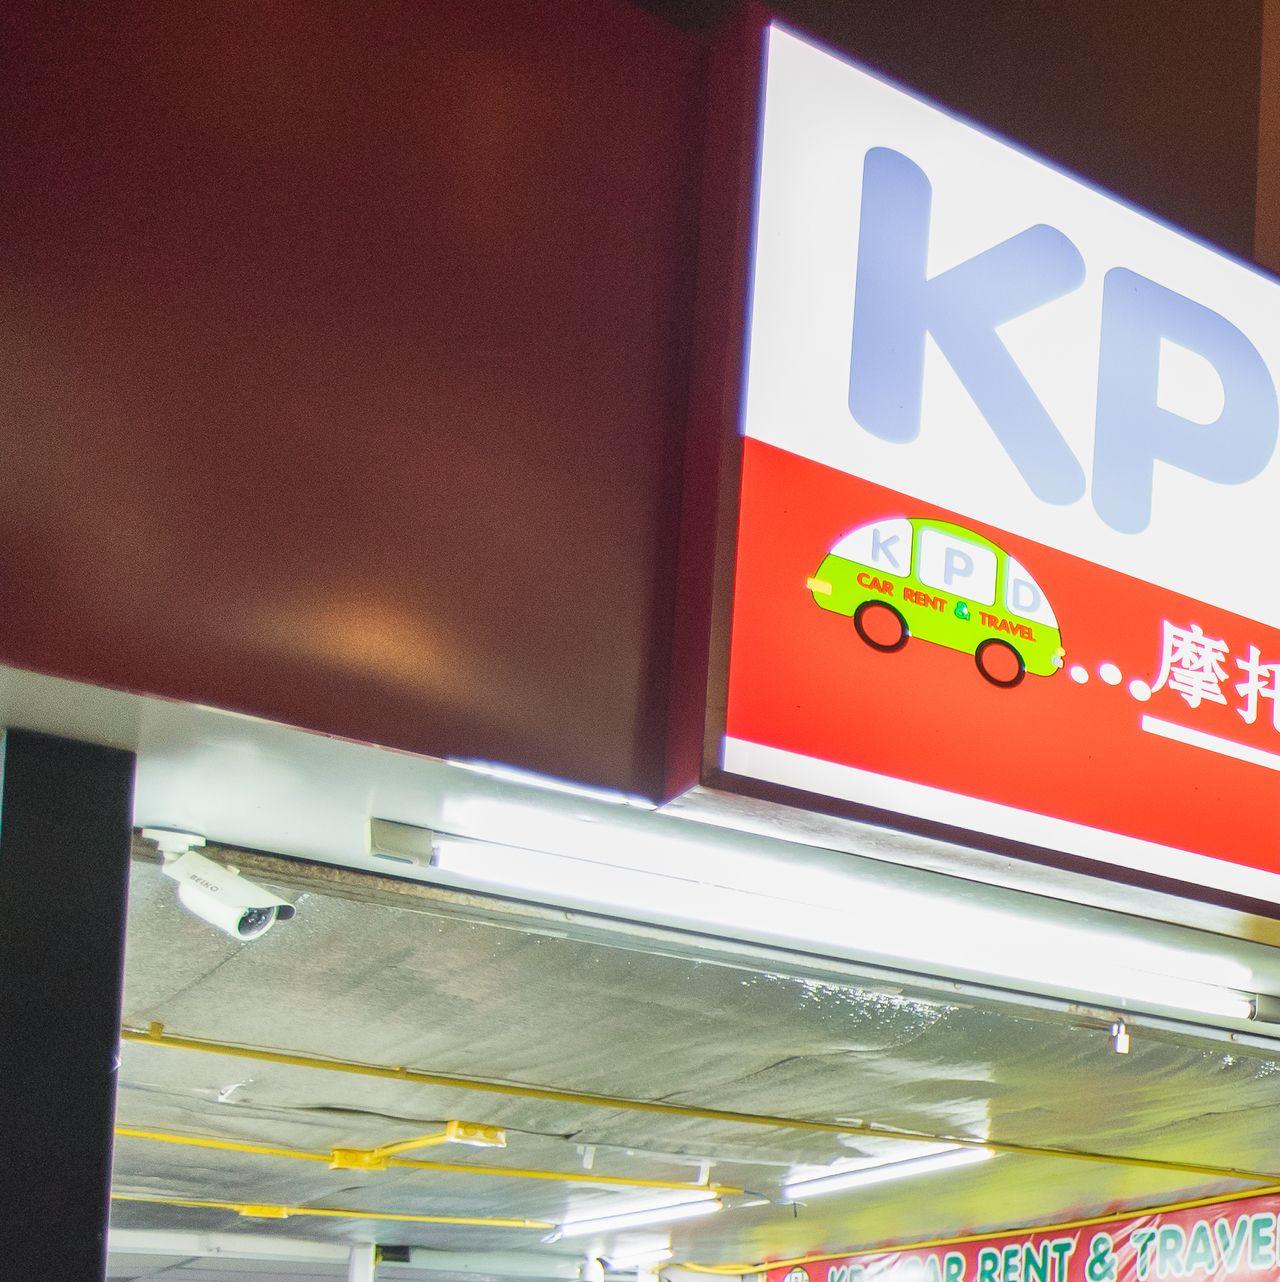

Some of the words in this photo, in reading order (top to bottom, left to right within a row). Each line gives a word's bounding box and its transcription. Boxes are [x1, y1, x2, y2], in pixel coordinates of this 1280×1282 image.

[857, 572, 894, 597] CAR
[903, 587, 948, 612] RENT
[954, 601, 970, 621] &
[979, 611, 1037, 642] TRAVEL
